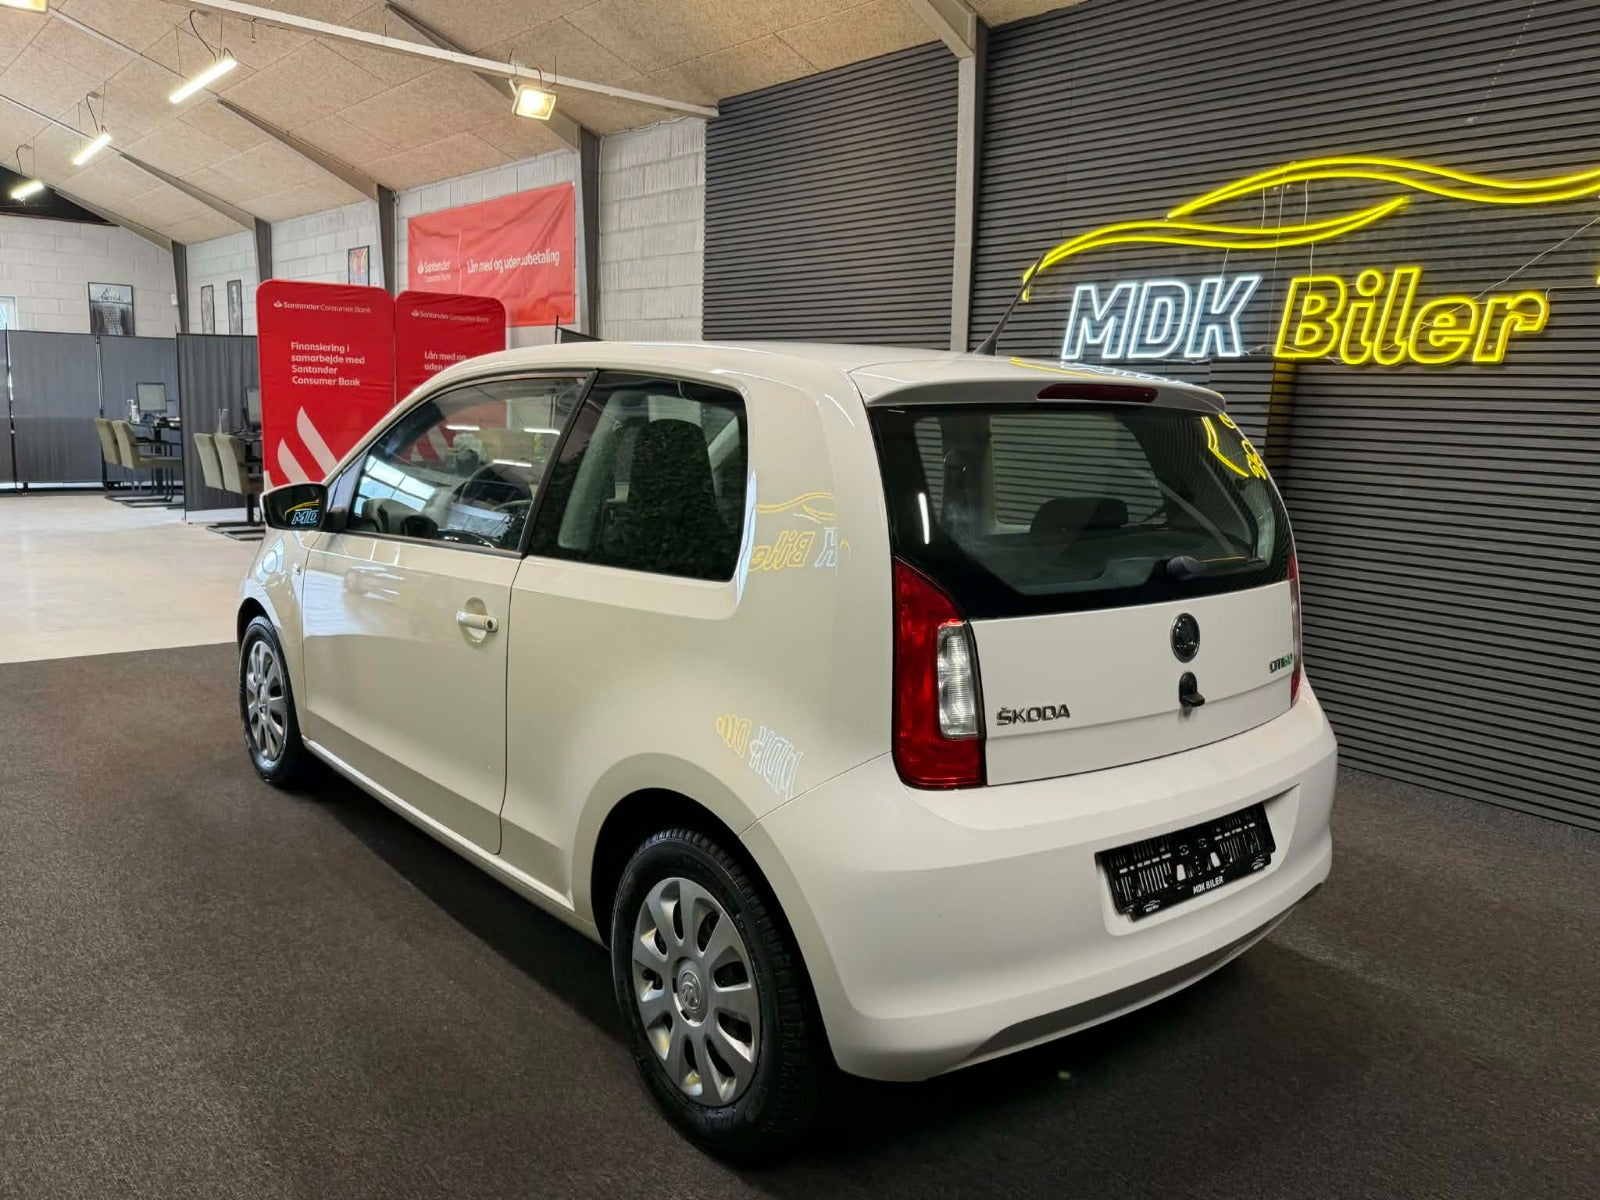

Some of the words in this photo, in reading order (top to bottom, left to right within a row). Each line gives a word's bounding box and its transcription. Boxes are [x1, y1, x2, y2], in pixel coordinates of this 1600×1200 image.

[493, 259, 504, 274] og
[283, 301, 320, 311] Santander
[1060, 274, 1261, 360] MDK
[1273, 265, 1551, 367] Biler
[291, 341, 345, 354] Finansiering
[346, 343, 350, 353] i
[291, 354, 344, 365] samarbejde
[345, 355, 366, 365] med
[424, 350, 438, 360] Lån
[438, 352, 455, 361] med
[291, 364, 338, 375] Santander
[424, 362, 443, 371] uden
[292, 375, 337, 386] Consumer
[338, 376, 361, 387] Bank
[996, 703, 1070, 726] ŠKODA
[1205, 875, 1224, 890] BILER
